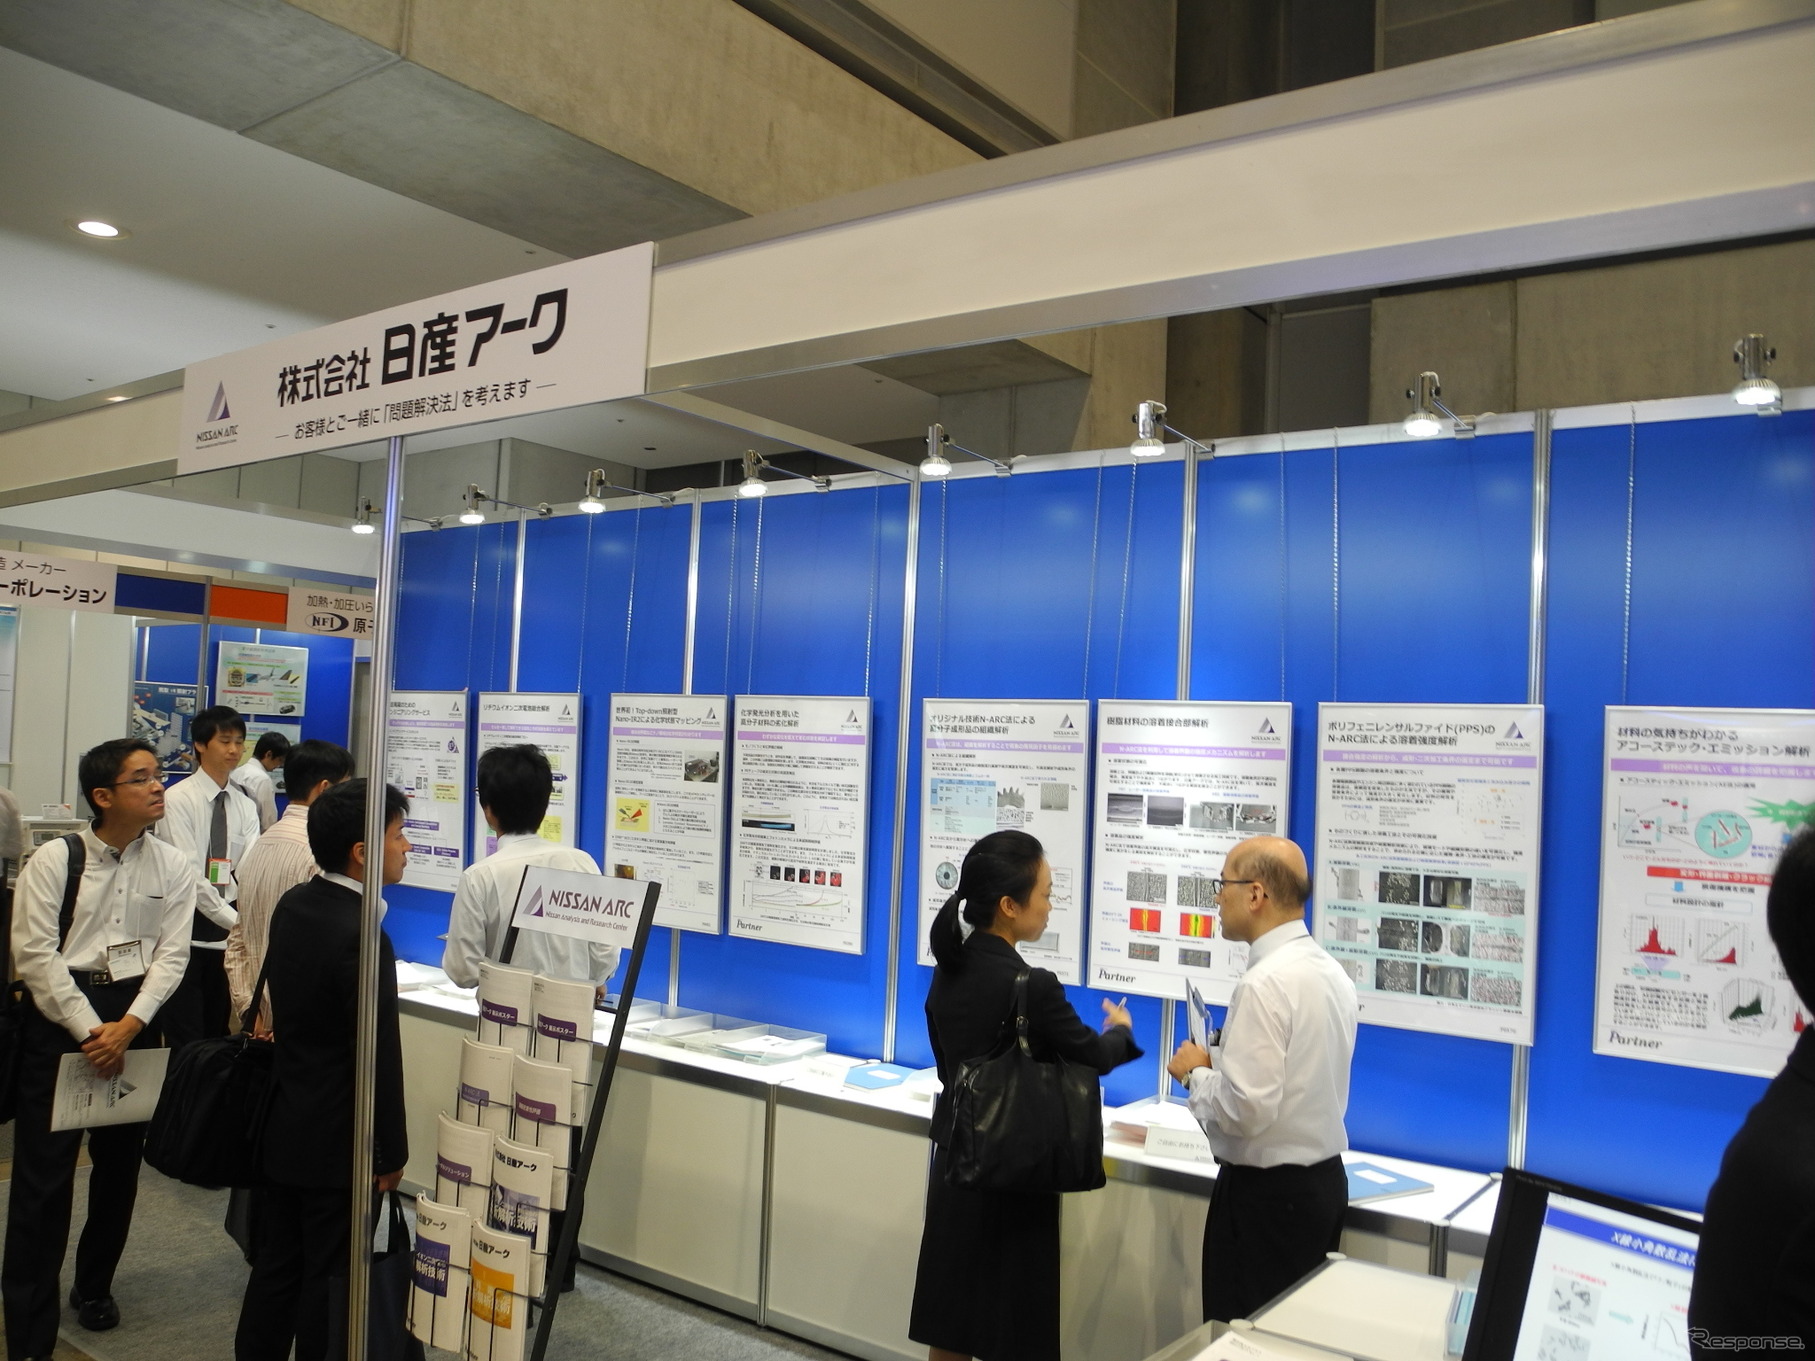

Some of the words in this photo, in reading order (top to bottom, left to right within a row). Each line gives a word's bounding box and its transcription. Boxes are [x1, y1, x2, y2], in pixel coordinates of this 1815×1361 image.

[278, 346, 371, 407] 株式会社
[381, 288, 569, 385] 日産アーク
[293, 378, 531, 440] お客様とご一緒に「問題解決法」を考えます
[196, 427, 223, 443] NISSAN
[224, 424, 239, 437] ARC
[12, 560, 67, 575] メーカー
[312, 615, 334, 628] NFI
[1107, 716, 1209, 729] 樹脂材料の溶着接合部解析
[1328, 734, 1458, 747] N-ARC法による溶着強度解析
[1617, 727, 1739, 742] 材料の気持ちがわかる
[548, 889, 603, 913] NISSAN
[602, 898, 635, 919] ARC
[545, 911, 561, 920] Nissan
[561, 914, 580, 924] Analysis
[737, 919, 763, 932] Partner
[1098, 967, 1137, 985] Partner
[1608, 1030, 1664, 1050] Partner
[506, 1156, 538, 1172] 日産アーク
[418, 1212, 447, 1231] 日産アーク
[478, 1239, 510, 1259] 日産アーク
